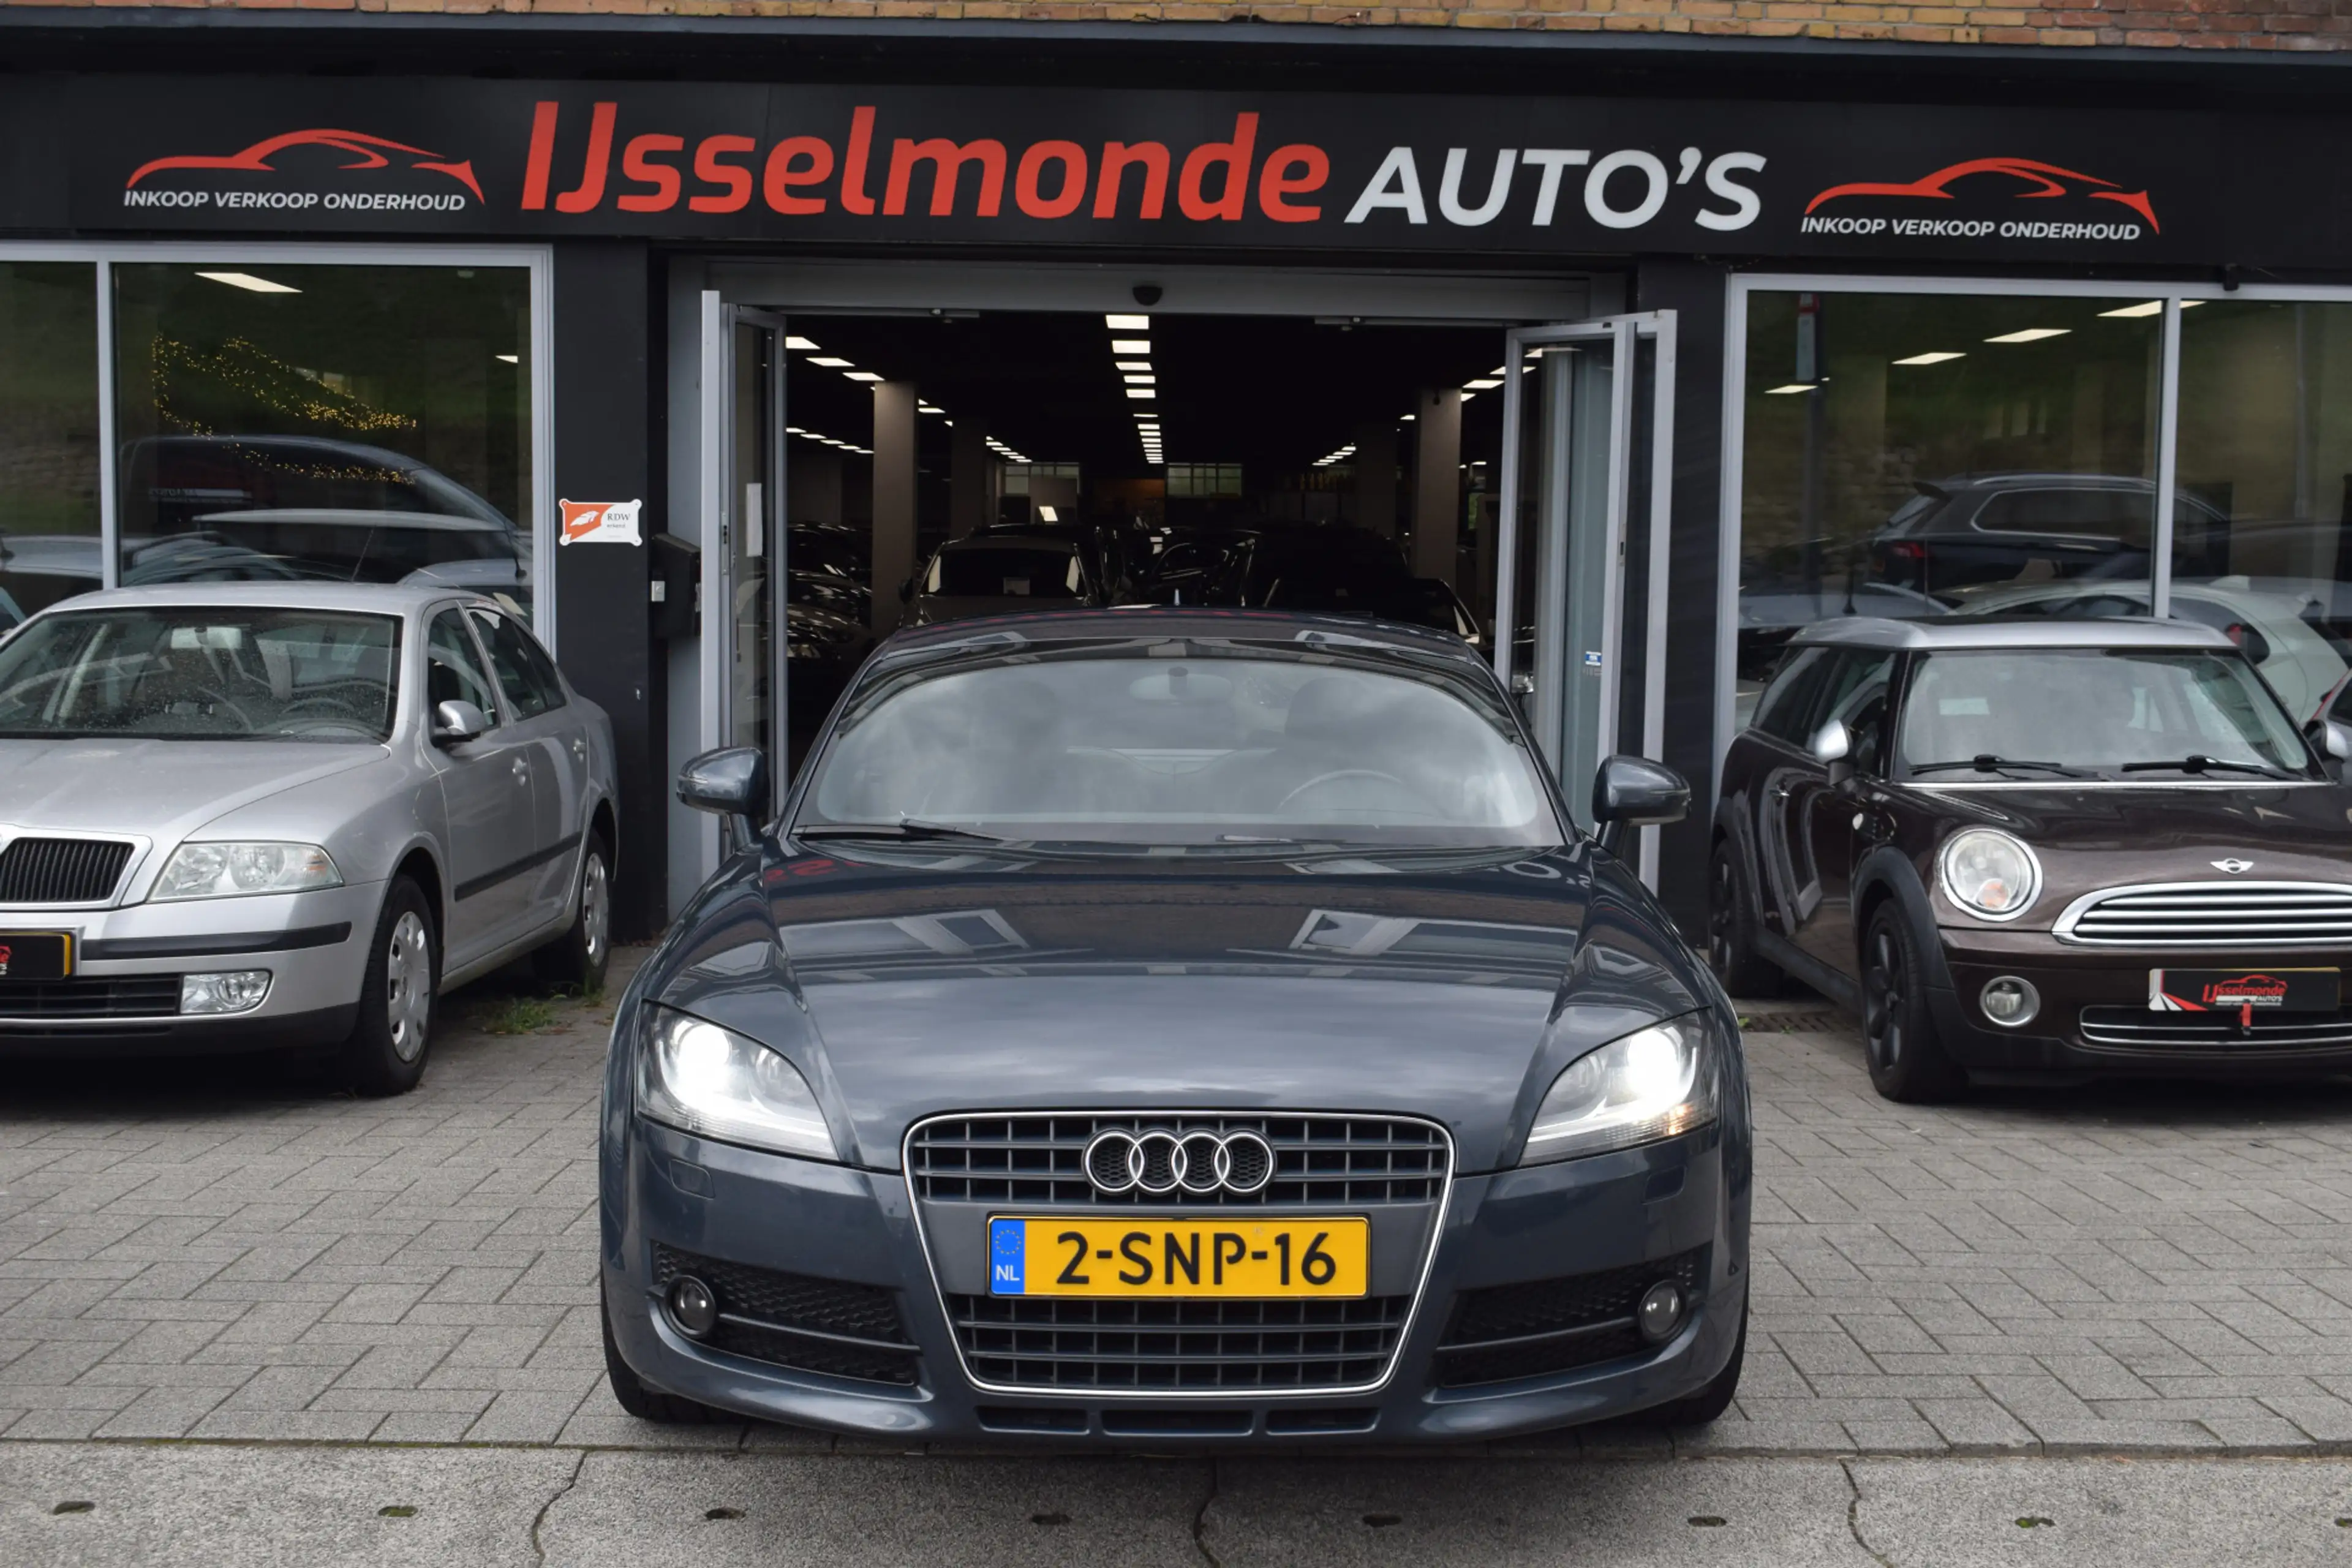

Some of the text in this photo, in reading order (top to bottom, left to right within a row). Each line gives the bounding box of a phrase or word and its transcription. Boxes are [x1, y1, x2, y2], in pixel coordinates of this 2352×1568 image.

[522, 101, 1767, 231] IJsselmonde AUTO'S
[124, 190, 466, 211] INKOOP VERKOOP ONDERHOUD
[1801, 217, 2140, 240] INKOOP VERKOOP ONDERHOUD
[1057, 1232, 1336, 1286] 2-SNP-16
[996, 1265, 1020, 1281] NL
